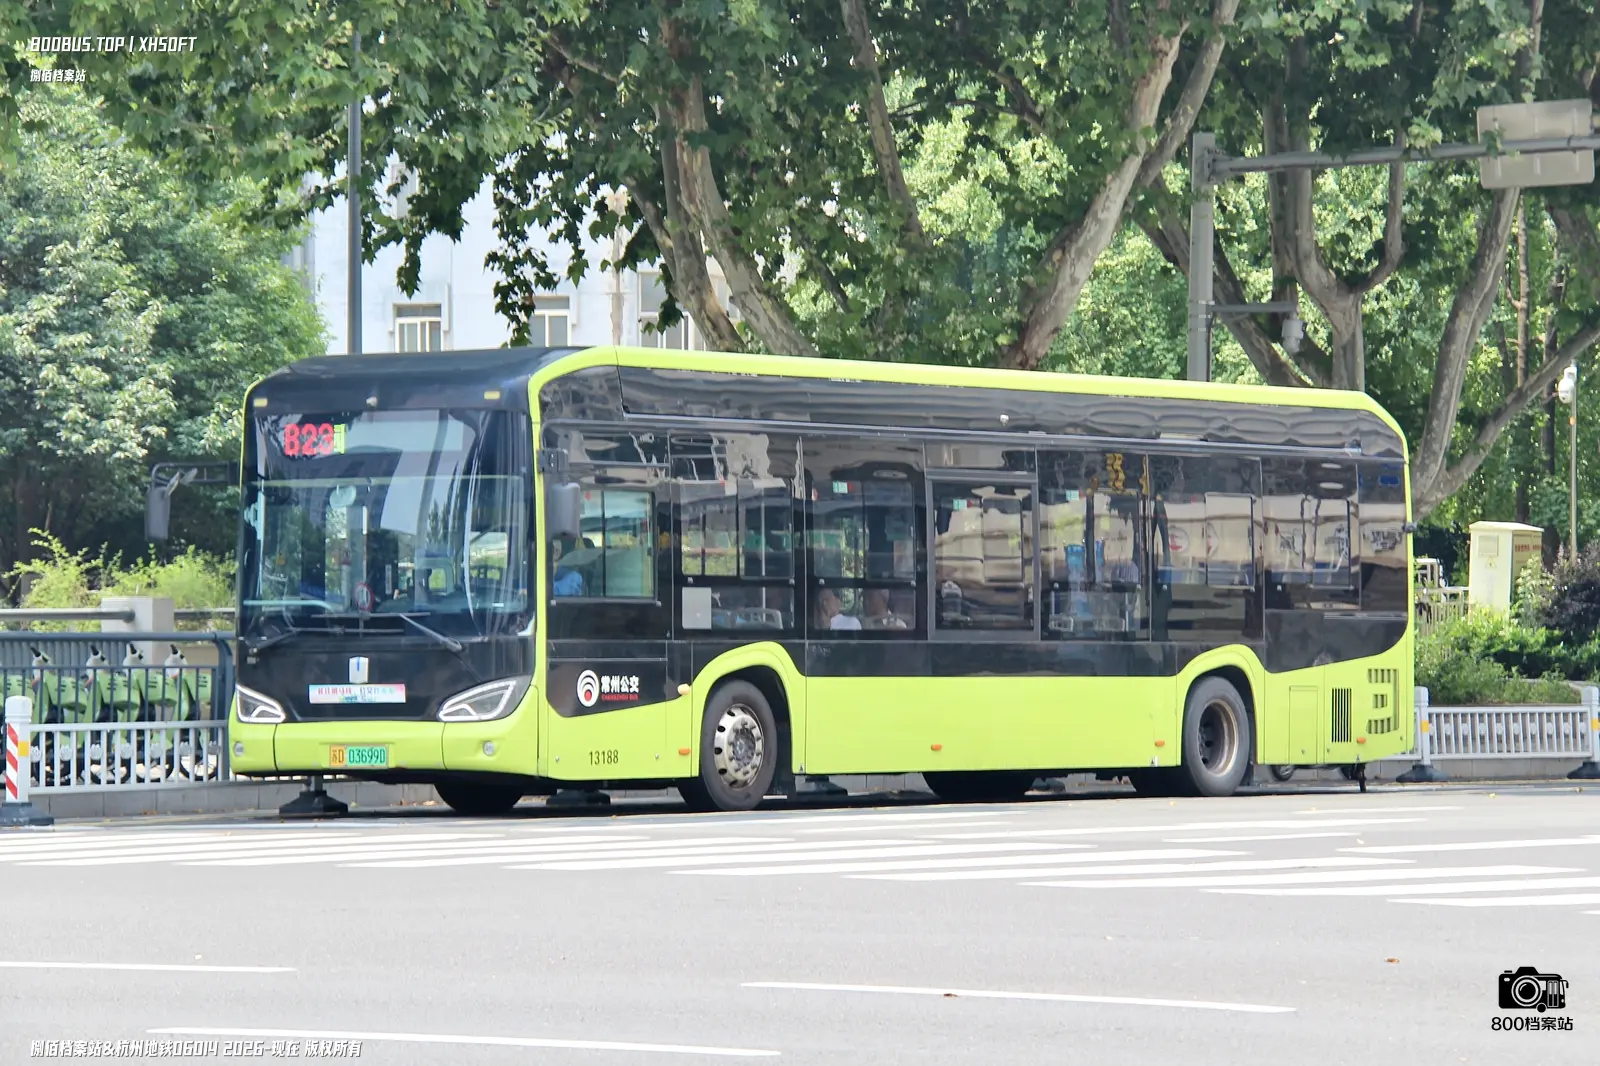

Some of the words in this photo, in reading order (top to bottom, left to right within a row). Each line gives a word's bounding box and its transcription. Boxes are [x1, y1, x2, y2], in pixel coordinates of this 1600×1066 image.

[601, 675, 639, 693] 常州公交
[589, 749, 619, 766] 13188
